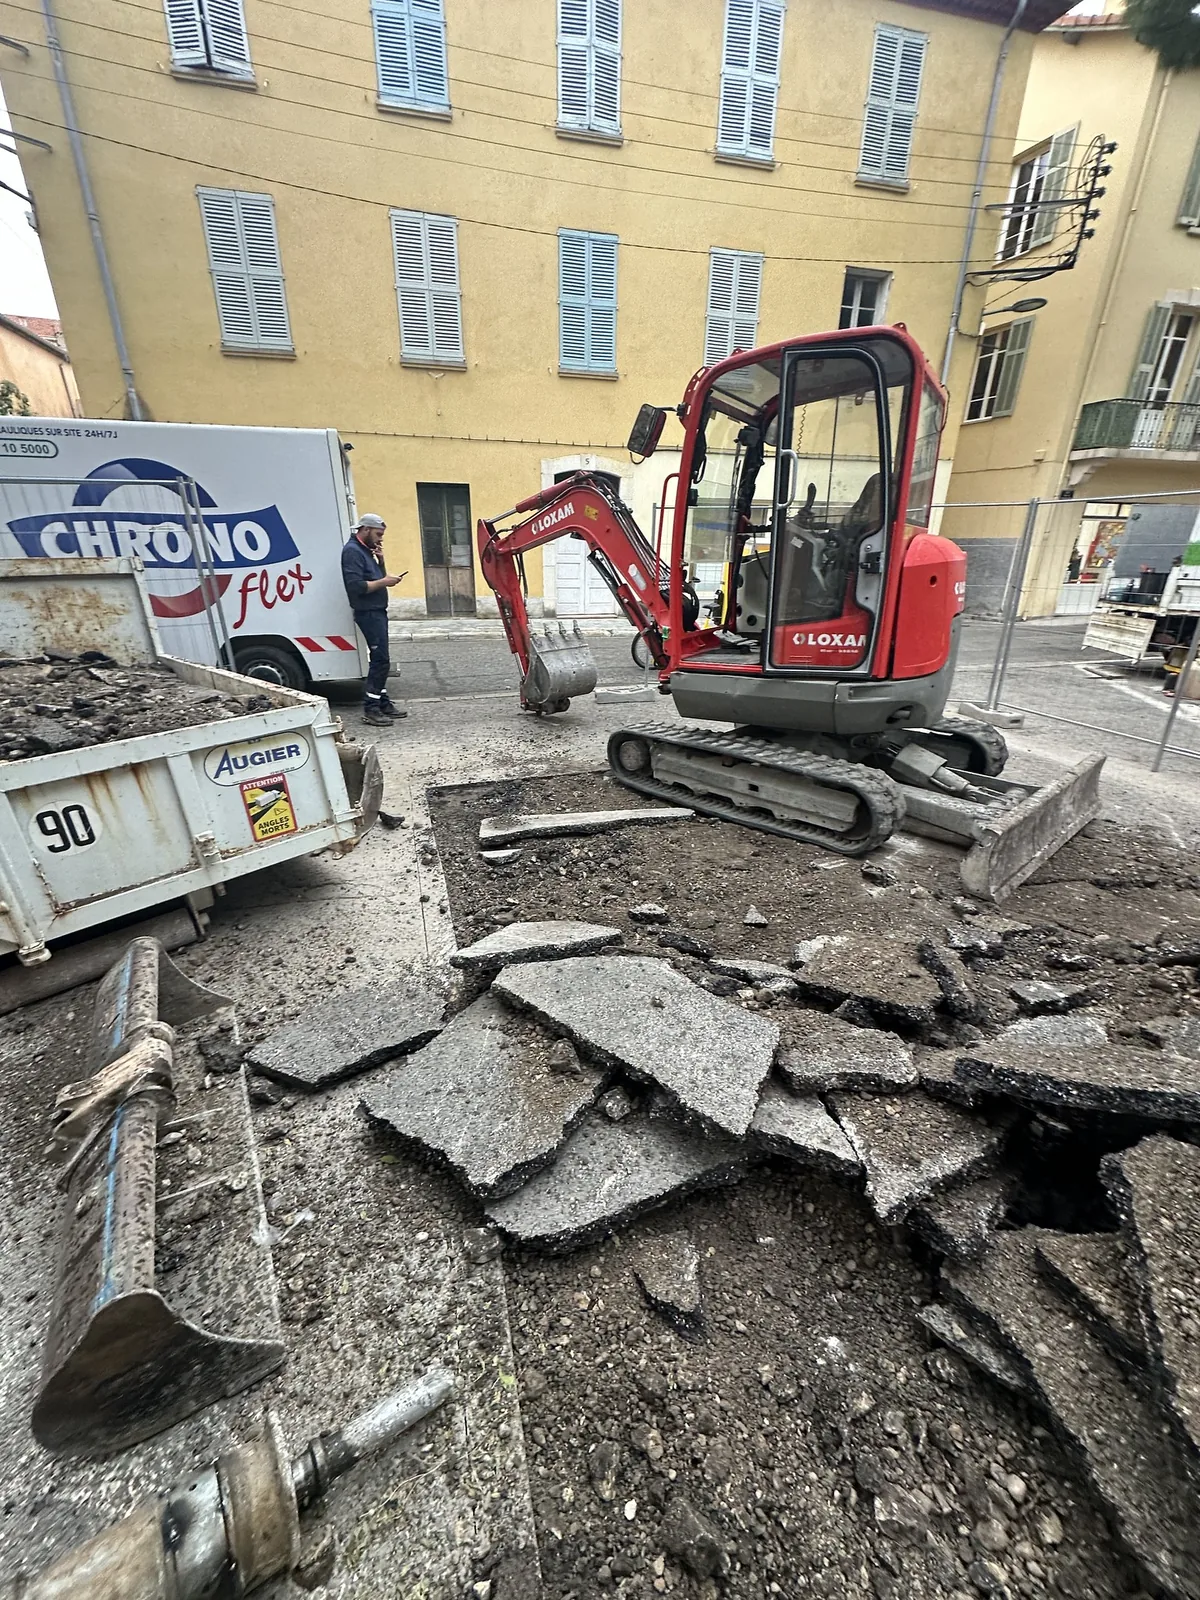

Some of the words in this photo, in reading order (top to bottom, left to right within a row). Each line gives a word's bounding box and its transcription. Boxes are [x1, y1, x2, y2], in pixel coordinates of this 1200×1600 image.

[46, 427, 61, 436] SUR
[64, 428, 81, 437] SITE
[85, 429, 118, 439] 24H/7J
[2, 443, 17, 453] 10
[20, 444, 50, 454] 5000
[538, 502, 575, 531] LOXAM
[40, 520, 271, 562] CHRONO
[233, 563, 312, 629] flex
[213, 744, 301, 779] AUGIER
[242, 775, 284, 791] ATTENTION
[36, 804, 96, 853] 90
[258, 816, 290, 830] ANGLES
[261, 823, 290, 836] MORTS
